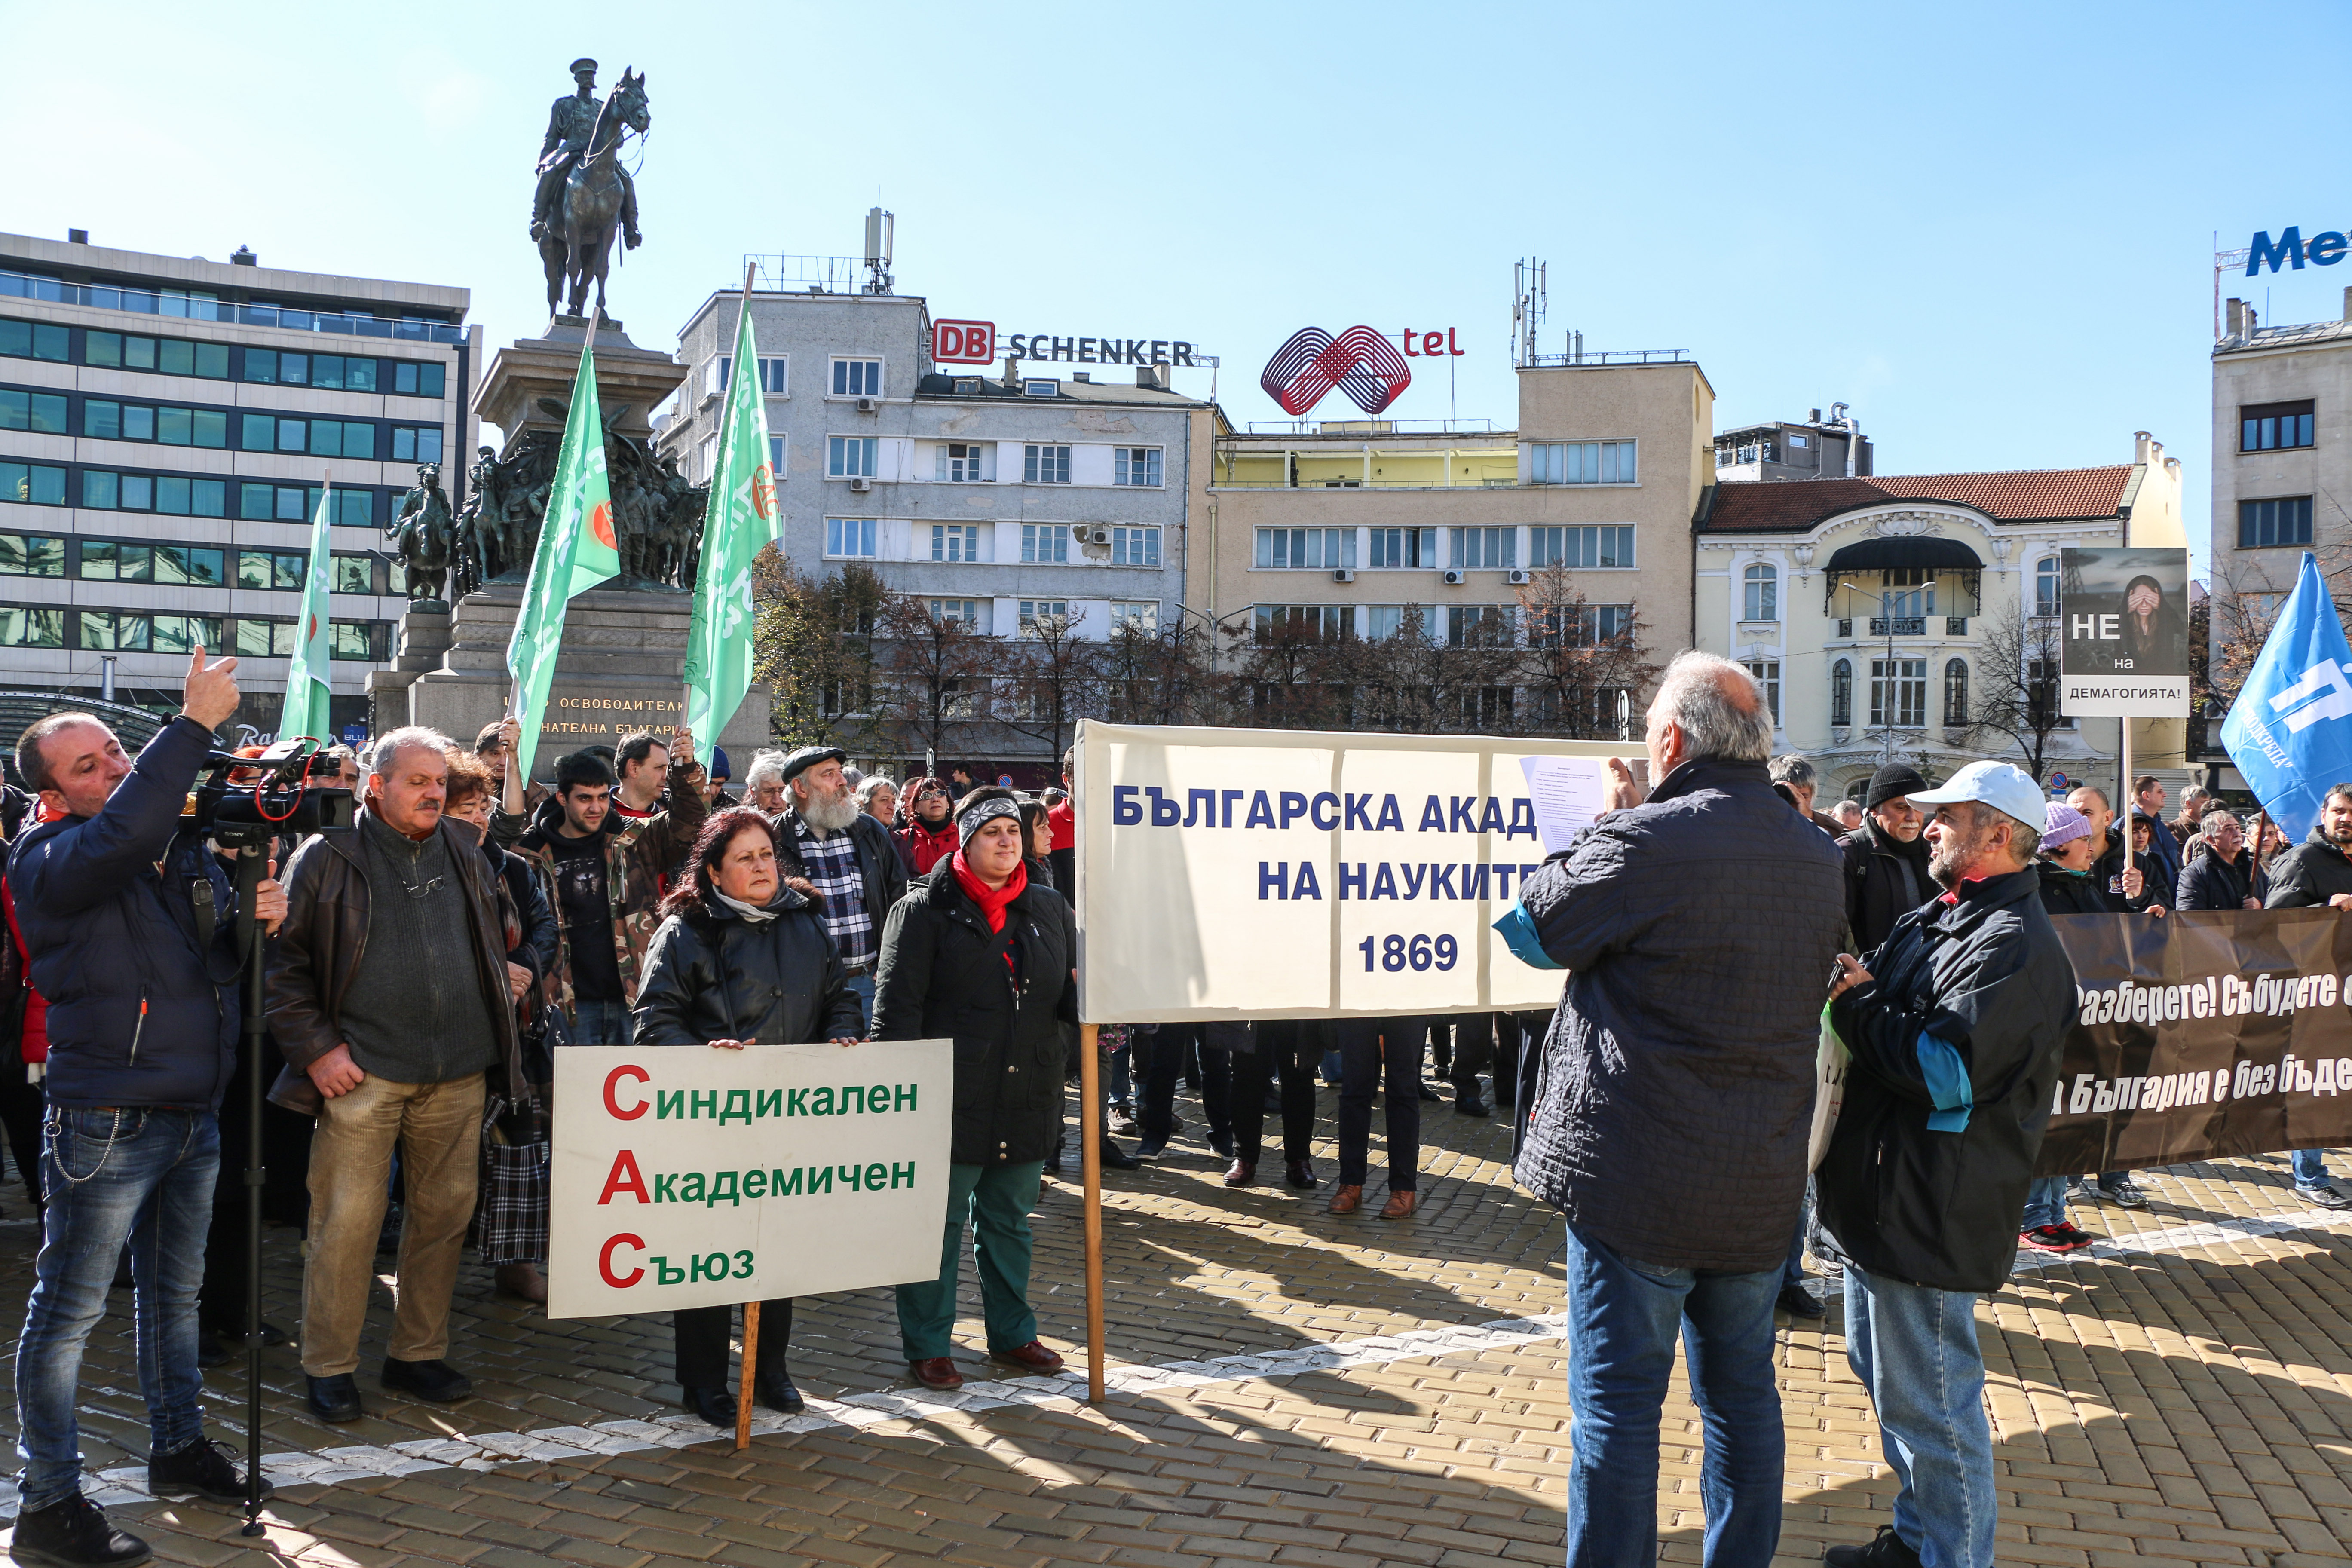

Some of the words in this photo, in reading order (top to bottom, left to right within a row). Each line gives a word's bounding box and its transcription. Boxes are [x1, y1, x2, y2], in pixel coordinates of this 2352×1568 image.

[2245, 226, 2352, 277] Me
[940, 325, 988, 358] DB
[1009, 334, 1193, 367] SCHENKER
[1404, 327, 1464, 357] tel
[2072, 613, 2121, 640] НЕ
[2114, 658, 2134, 669] на
[2070, 688, 2181, 700] ДЕМАГОГИЯТА!
[1113, 785, 1403, 830] БЪЛГАРСКА
[1259, 862, 1322, 900] НА
[1359, 934, 1458, 972] 1869
[2221, 973, 2337, 1017] Събудете
[603, 1064, 918, 1126] Синдикален
[2069, 1070, 2210, 1115] България
[2213, 1068, 2230, 1102] е
[2233, 1060, 2276, 1099] без
[597, 1149, 916, 1209] Академичен
[598, 1232, 755, 1289] Съюз
